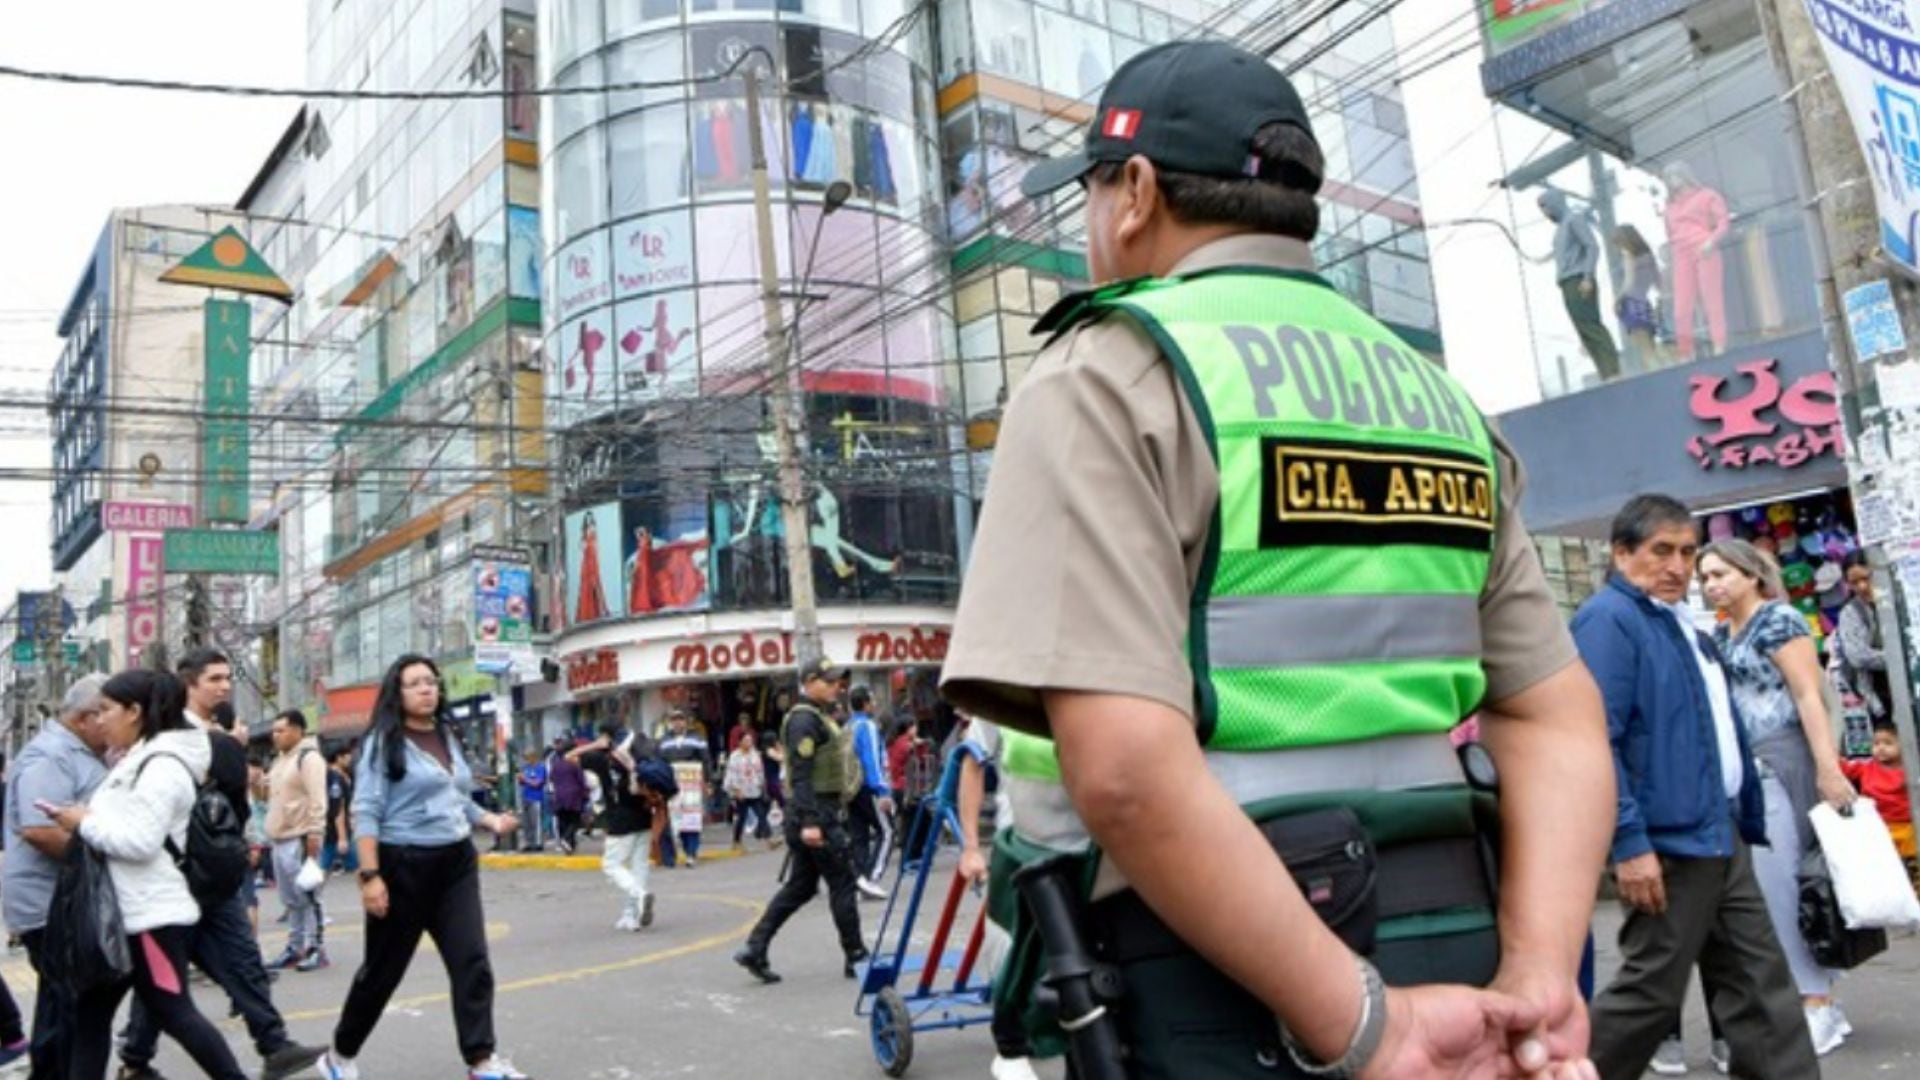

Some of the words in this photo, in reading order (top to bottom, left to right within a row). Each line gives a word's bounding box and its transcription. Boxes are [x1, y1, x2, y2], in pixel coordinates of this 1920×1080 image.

[1222, 323, 1475, 442] POLICIA
[1720, 424, 1846, 468] FASH
[1288, 461, 1365, 511] CIA.
[1384, 467, 1488, 518] APOLO
[107, 504, 189, 527] GALERIA
[669, 632, 796, 674] model
